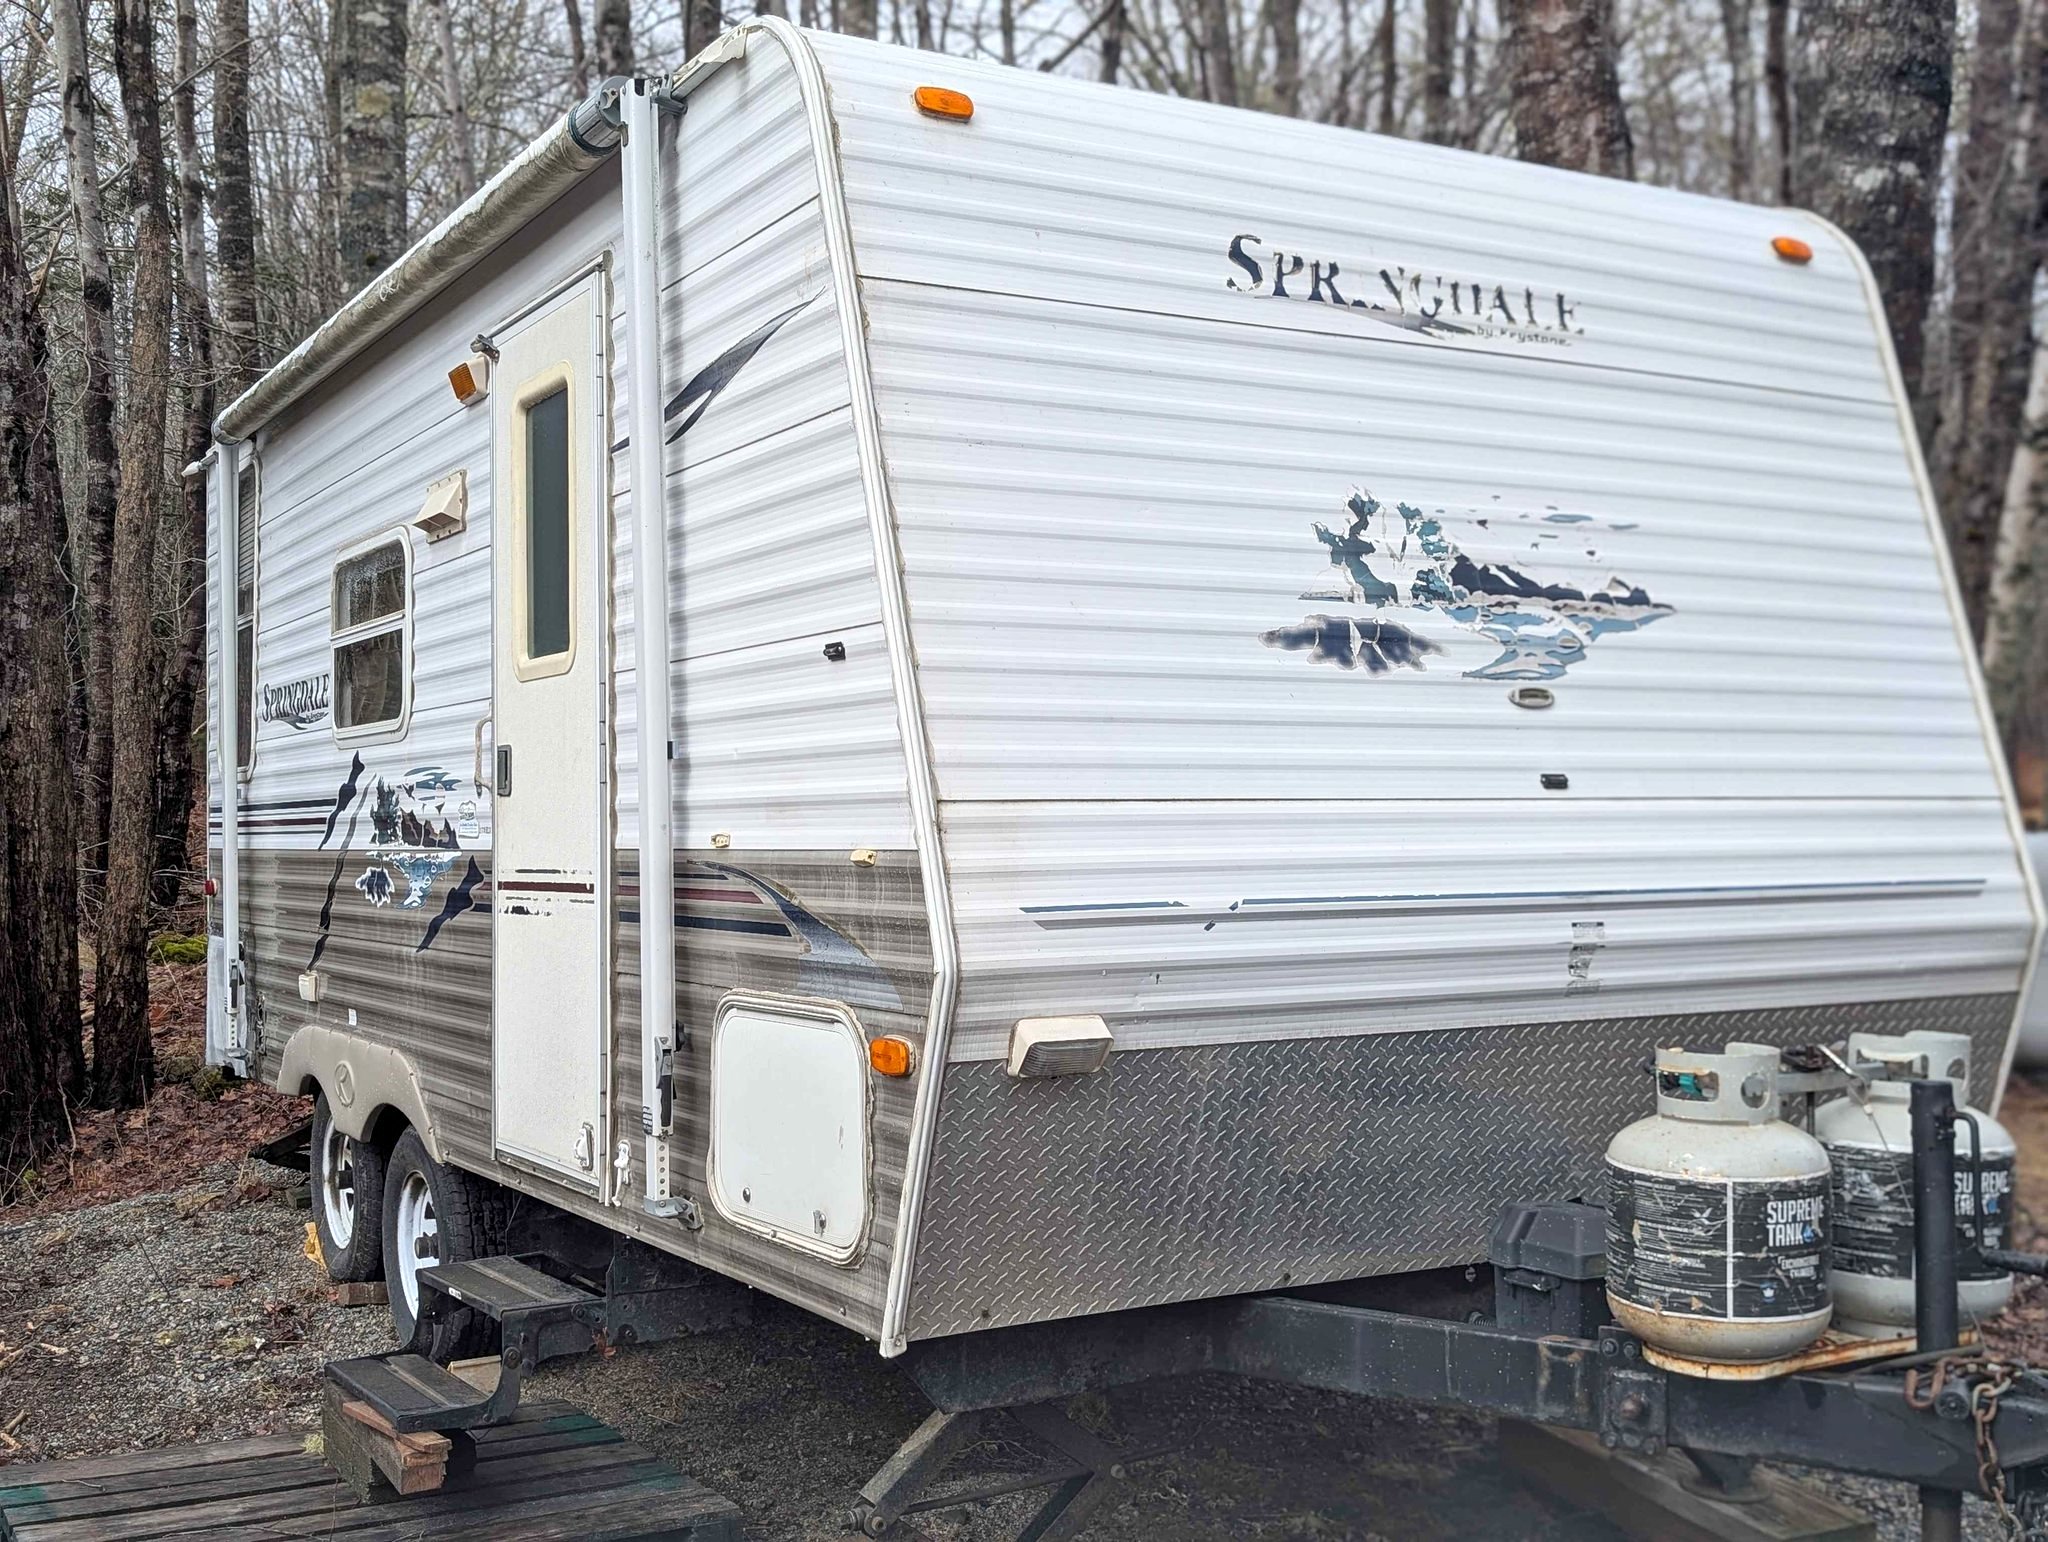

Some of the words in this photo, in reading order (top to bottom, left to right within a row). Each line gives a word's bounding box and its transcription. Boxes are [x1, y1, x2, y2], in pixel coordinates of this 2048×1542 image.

[1226, 233, 1584, 335] SPRNGDALE
[262, 673, 329, 722] SPRINGDALE
[1954, 1170, 2009, 1194] SUREME
[1766, 1195, 1824, 1224] SUPREME
[1766, 1222, 1804, 1248] TANK
